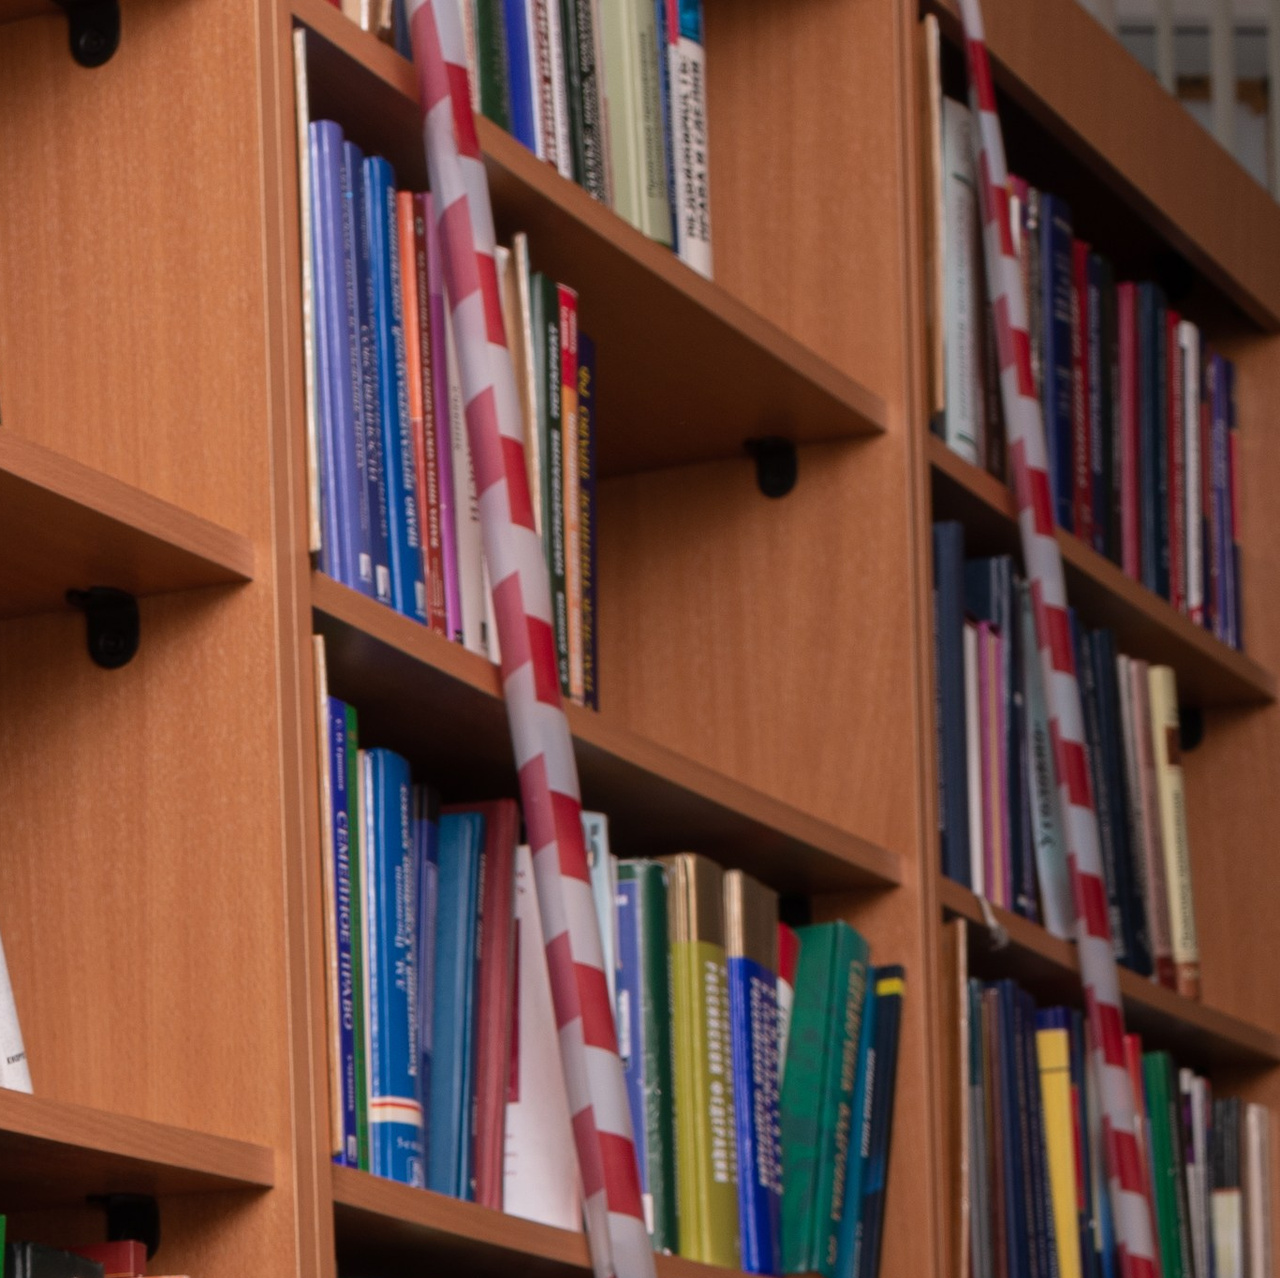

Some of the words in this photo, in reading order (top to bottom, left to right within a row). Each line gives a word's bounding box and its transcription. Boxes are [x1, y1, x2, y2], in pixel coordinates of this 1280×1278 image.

[335, 811, 352, 943] СЕМЕЙНОЕ
[340, 951, 353, 1030] ПРАВО
[709, 1080, 728, 1182] ФЕДЕРАЦИИ
